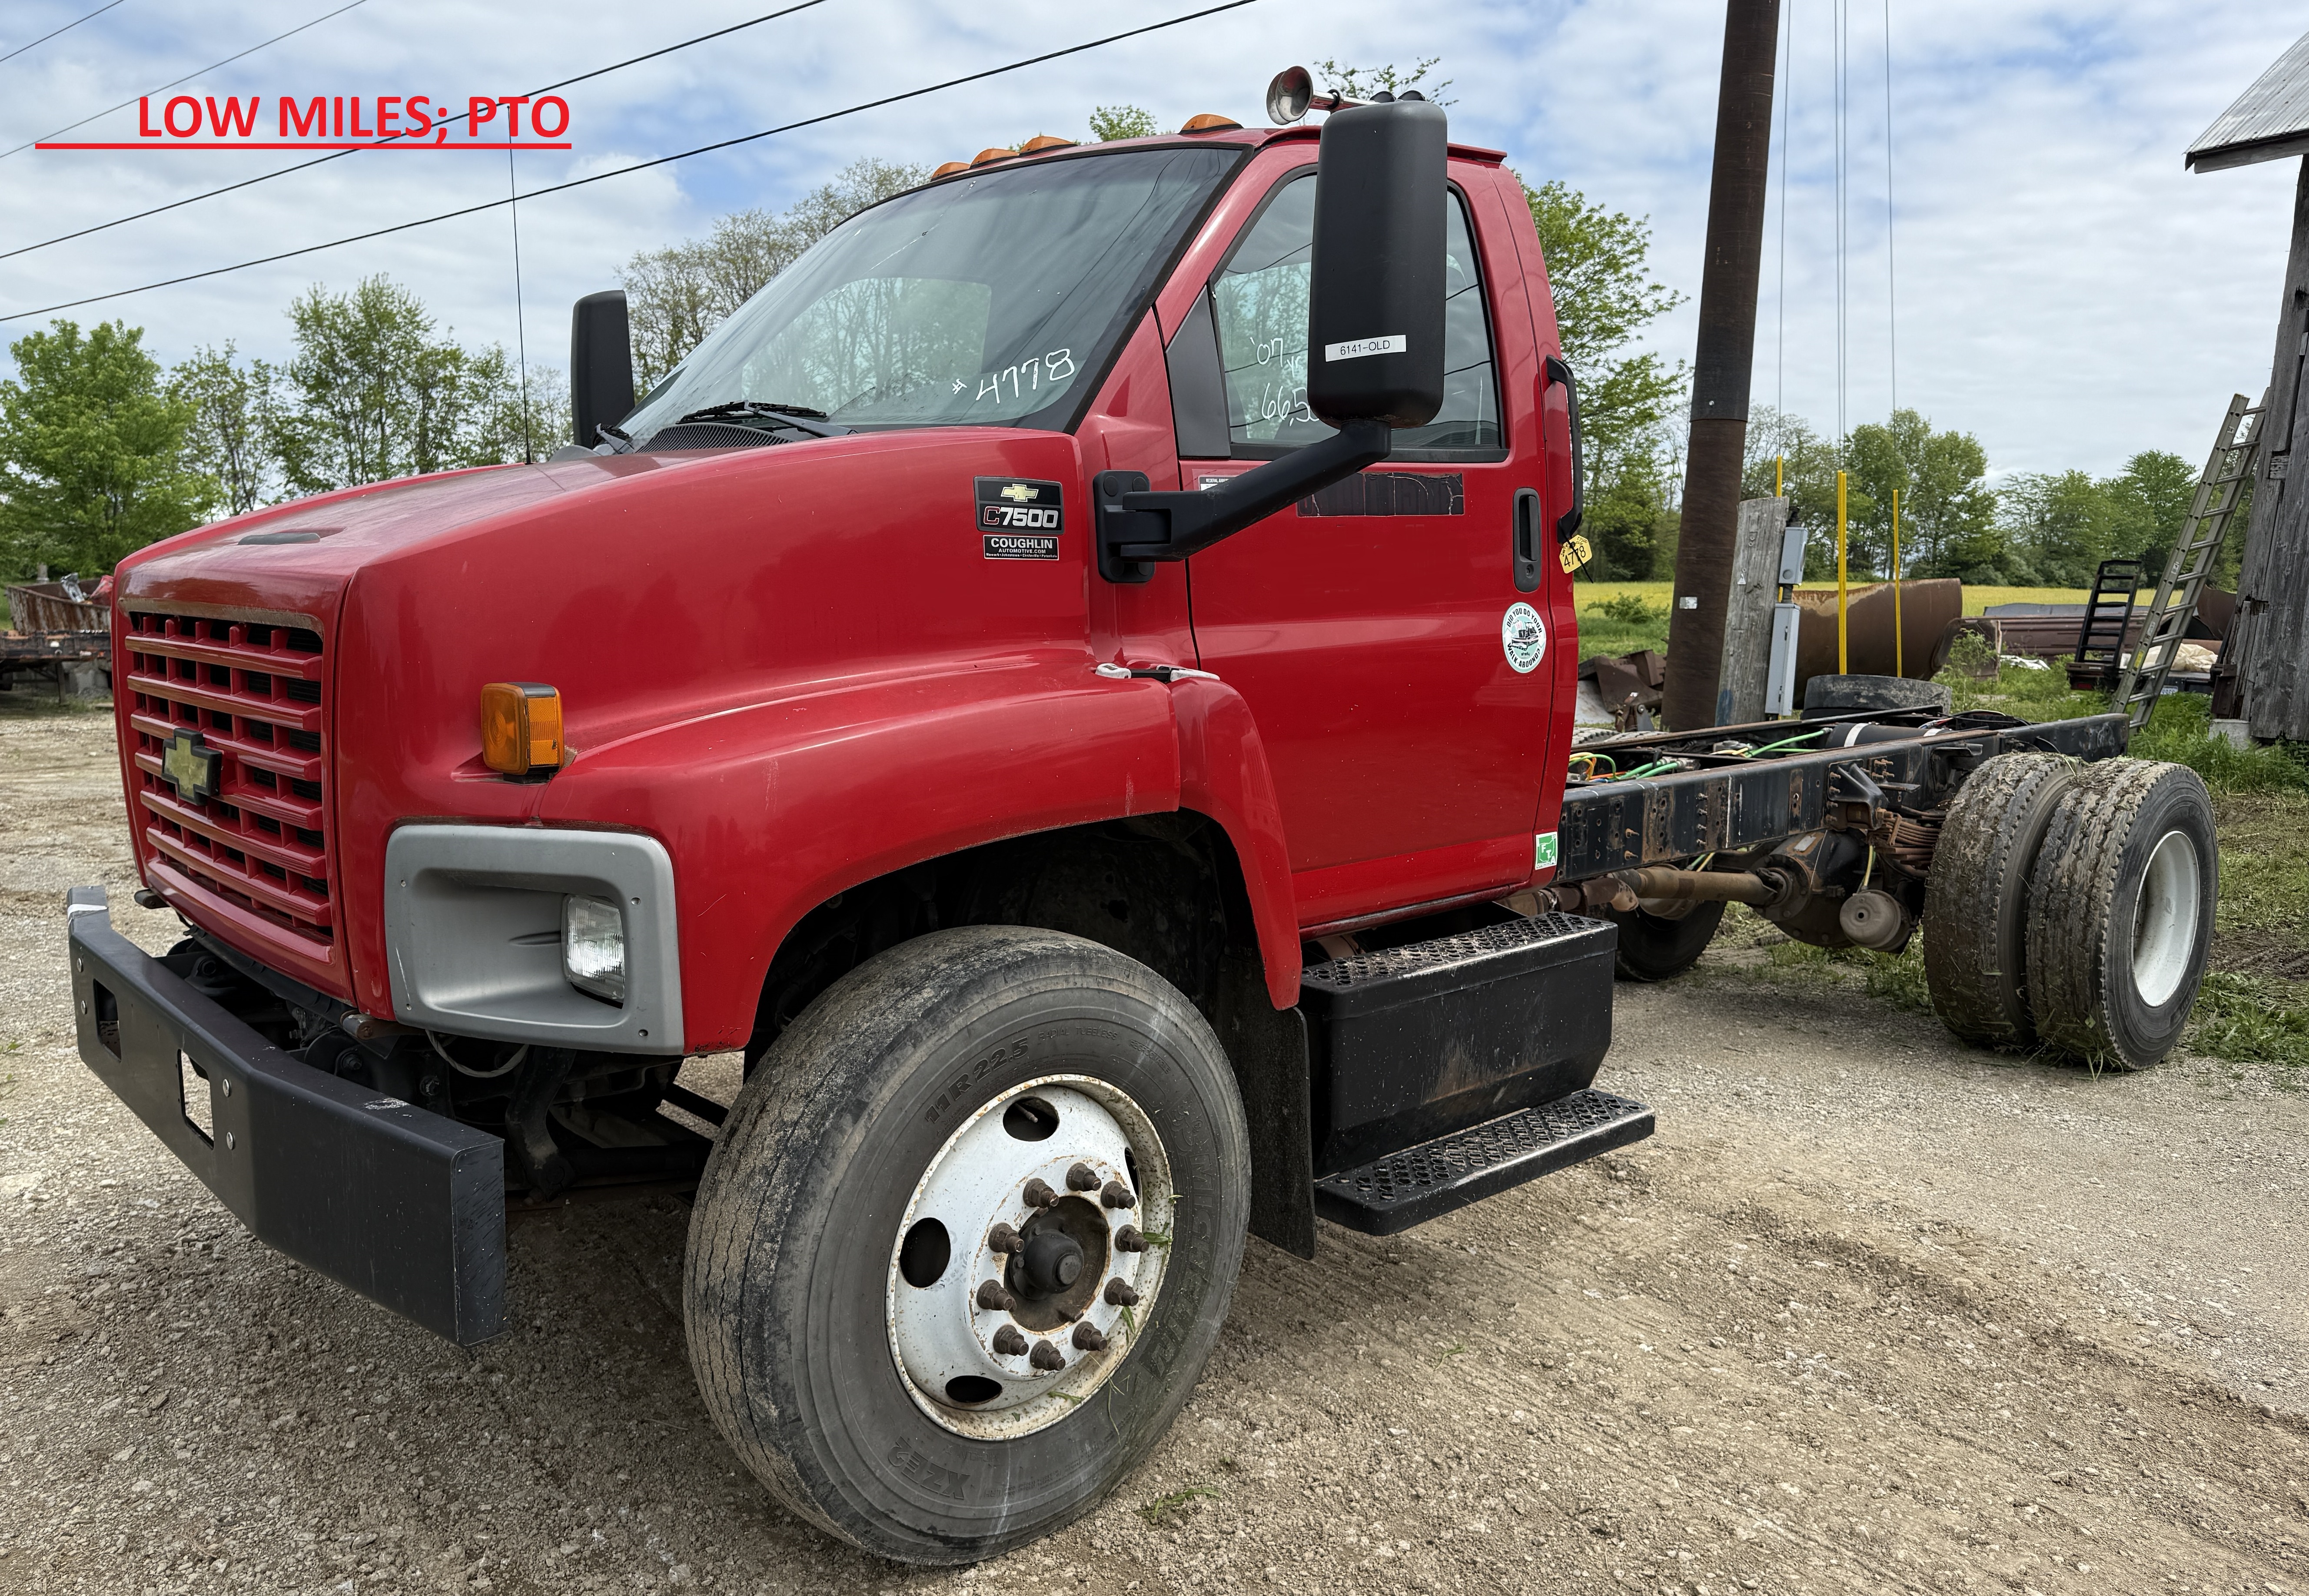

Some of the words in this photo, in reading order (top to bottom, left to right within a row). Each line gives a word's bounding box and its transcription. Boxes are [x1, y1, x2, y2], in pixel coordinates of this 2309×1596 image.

[1340, 340, 1390, 355] 6141-OLD
[983, 506, 1058, 528] C7500
[991, 538, 1053, 549] COUGHLIN
[1512, 607, 1522, 617] YOU
[1524, 608, 1530, 617] DO
[1532, 614, 1542, 633] YOUR
